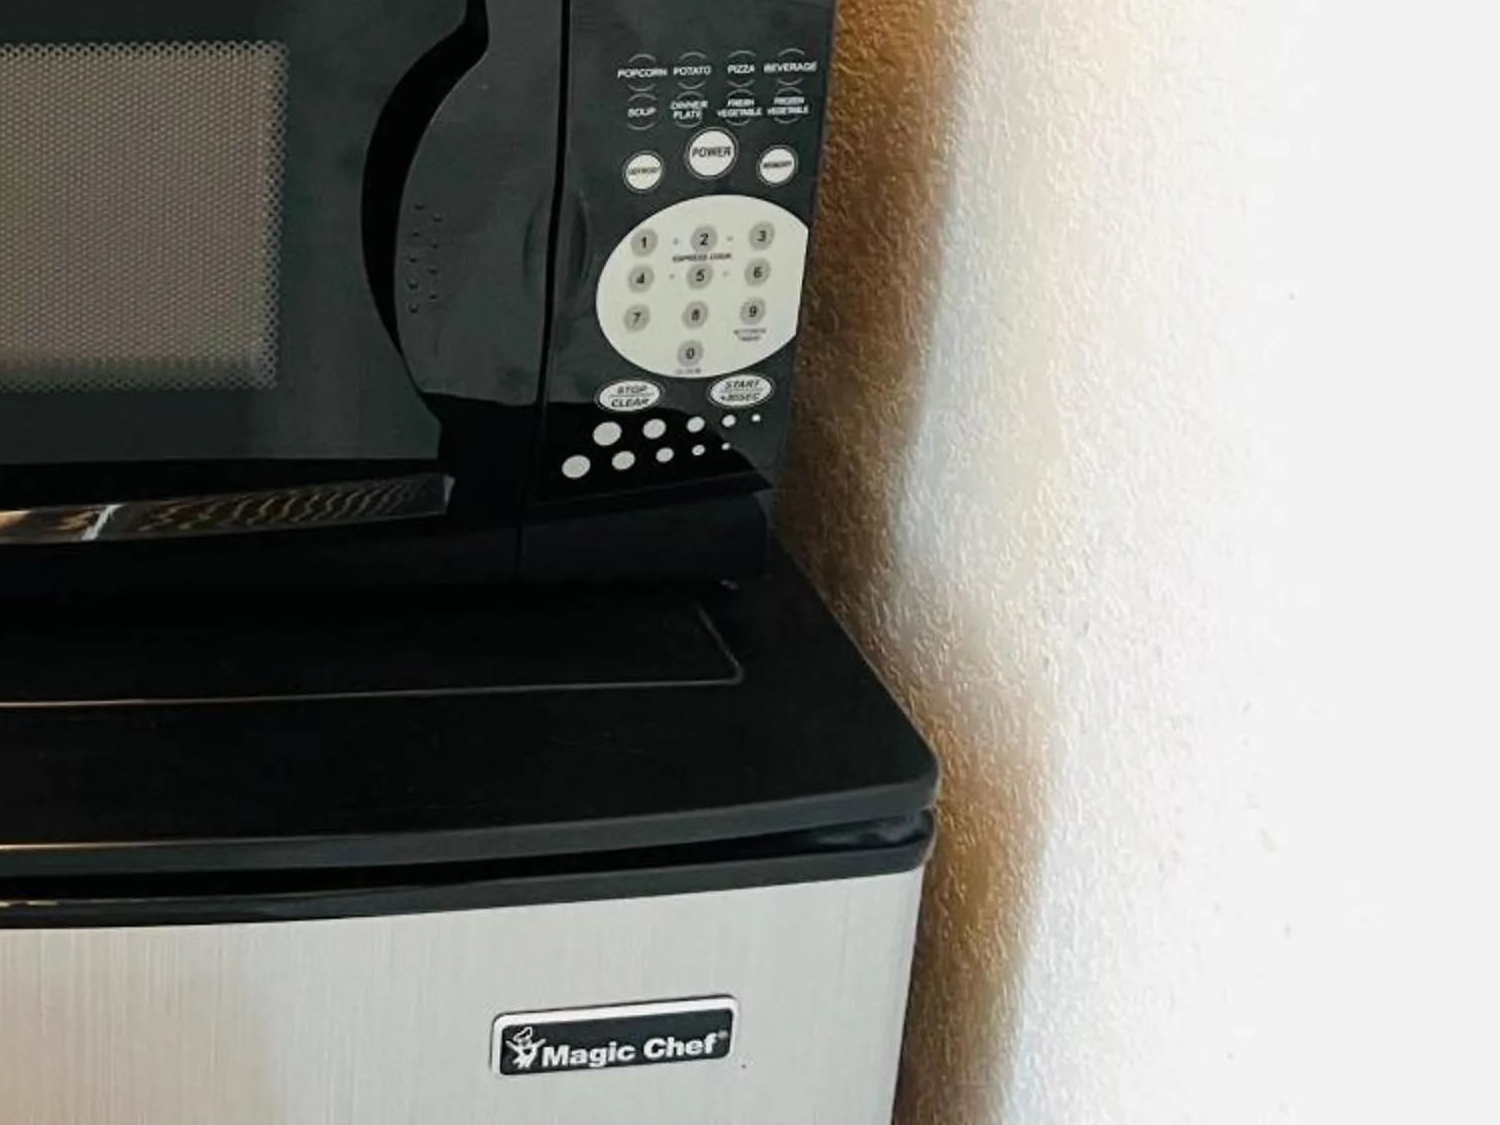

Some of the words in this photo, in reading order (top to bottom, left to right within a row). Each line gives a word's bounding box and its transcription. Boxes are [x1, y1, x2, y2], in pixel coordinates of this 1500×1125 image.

[617, 67, 667, 78] POPCORN
[673, 65, 711, 76] POTATO
[727, 63, 755, 75] PIZZA
[763, 61, 817, 74] BEVERAGE
[627, 107, 657, 118] SOUP
[691, 146, 731, 158] POWER
[640, 236, 647, 249] 1
[700, 234, 709, 246] 2
[758, 230, 767, 243] 3
[695, 270, 705, 283] 5
[753, 266, 762, 279] 6
[636, 273, 646, 285] 4
[691, 308, 700, 321] 8
[748, 305, 757, 318] 9
[633, 312, 641, 325] 7
[685, 347, 695, 360] 0
[617, 385, 648, 395] STOP
[725, 379, 761, 389] START
[611, 397, 650, 408] CLEAR
[542, 1041, 635, 1068] Magic
[643, 1032, 718, 1059] Chef
